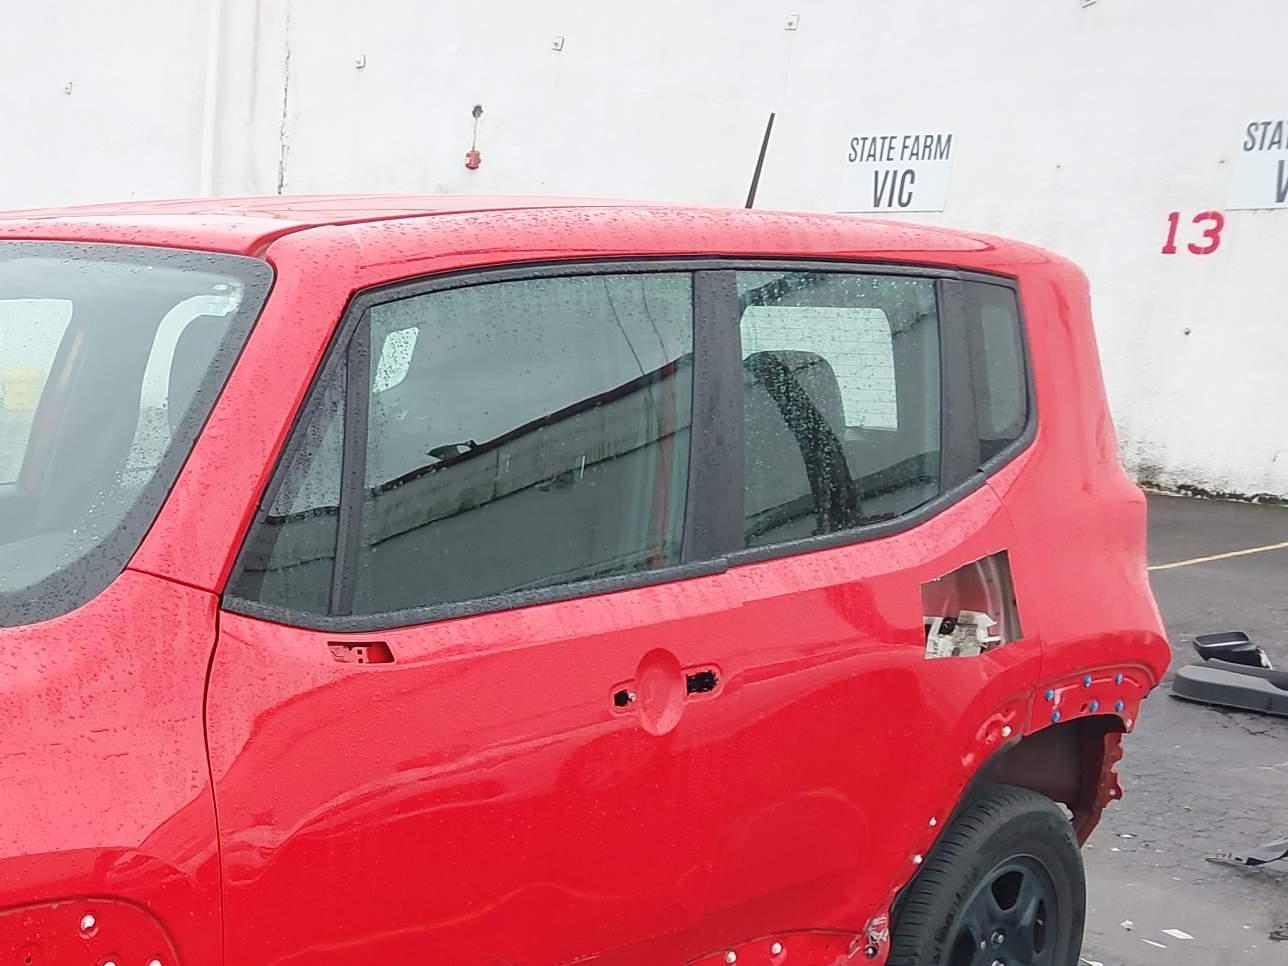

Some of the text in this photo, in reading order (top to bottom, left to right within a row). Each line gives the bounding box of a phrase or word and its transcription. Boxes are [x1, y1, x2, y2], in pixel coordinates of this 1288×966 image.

[848, 133, 952, 162] STATE FARM
[1242, 120, 1288, 152] STA
[873, 169, 916, 208] VIC
[1161, 210, 1225, 255] 13
